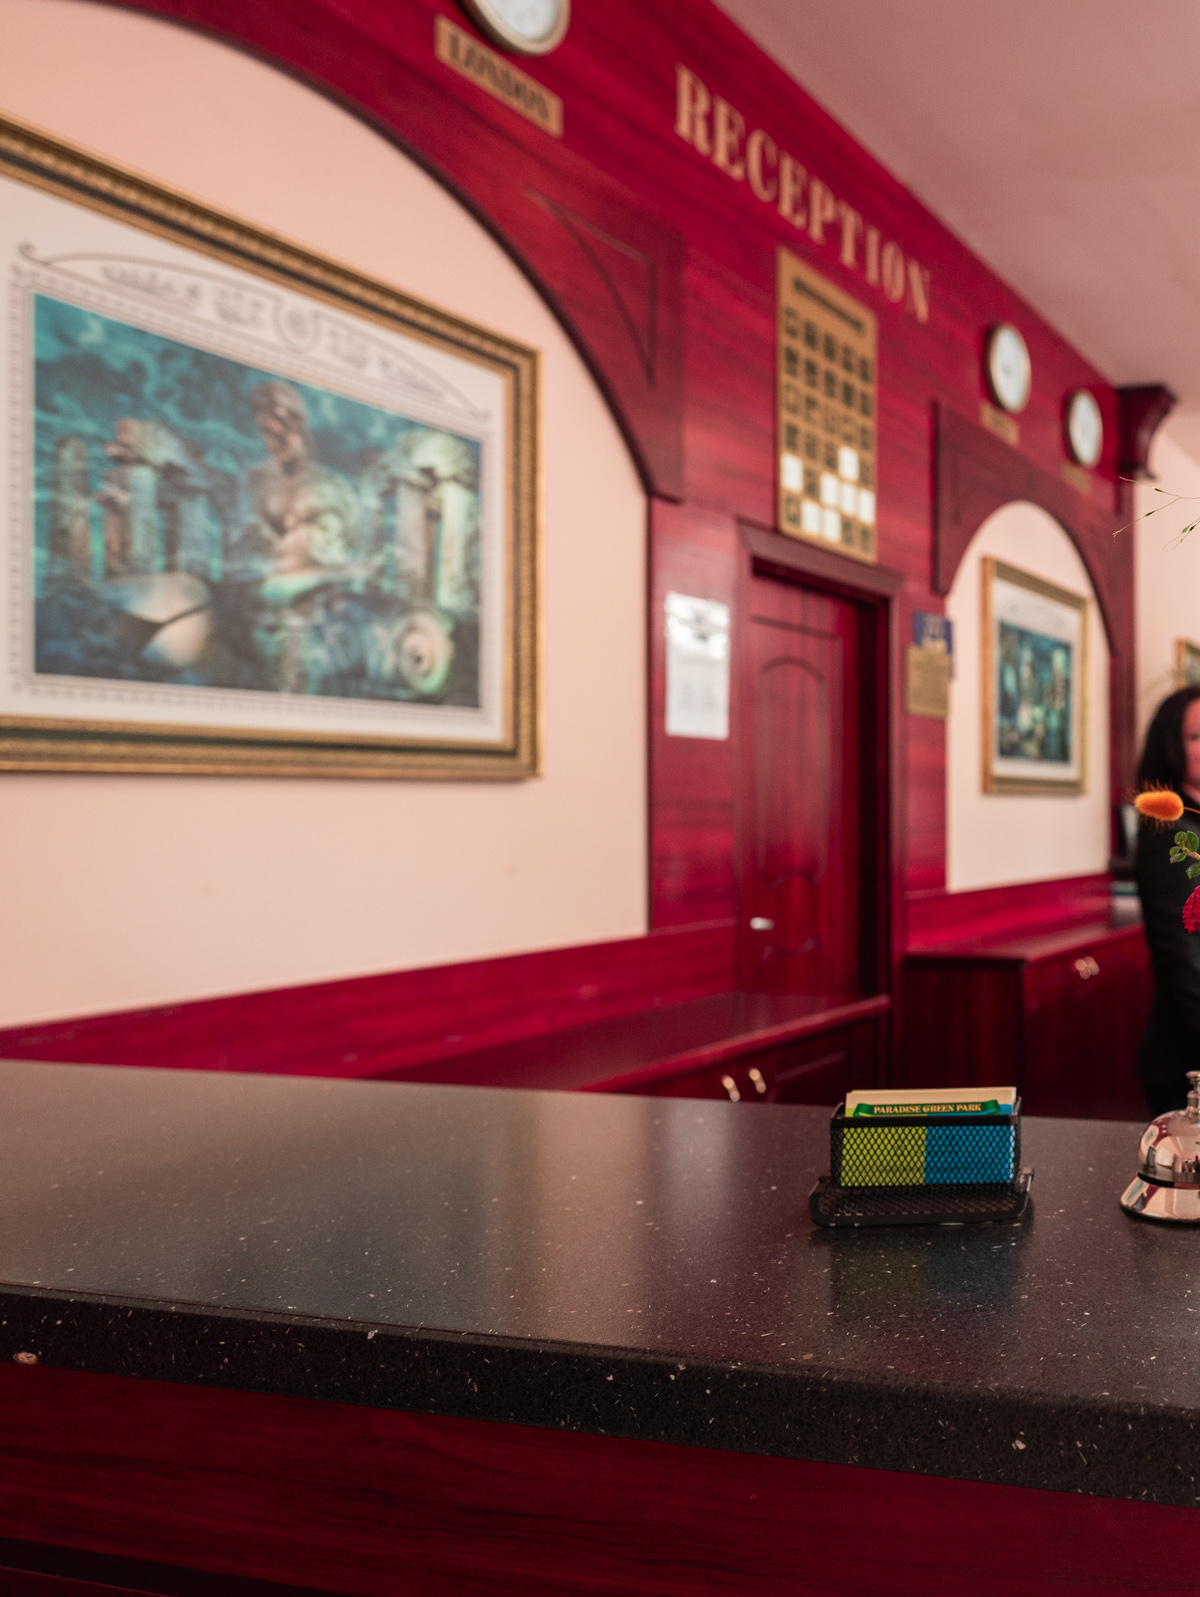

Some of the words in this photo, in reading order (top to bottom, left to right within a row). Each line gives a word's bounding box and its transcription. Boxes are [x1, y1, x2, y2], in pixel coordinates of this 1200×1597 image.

[674, 61, 931, 324] RECEPTION
[873, 1105, 921, 1114] PARADISE
[922, 1104, 954, 1113] GREEN
[956, 1103, 982, 1112] PARK
